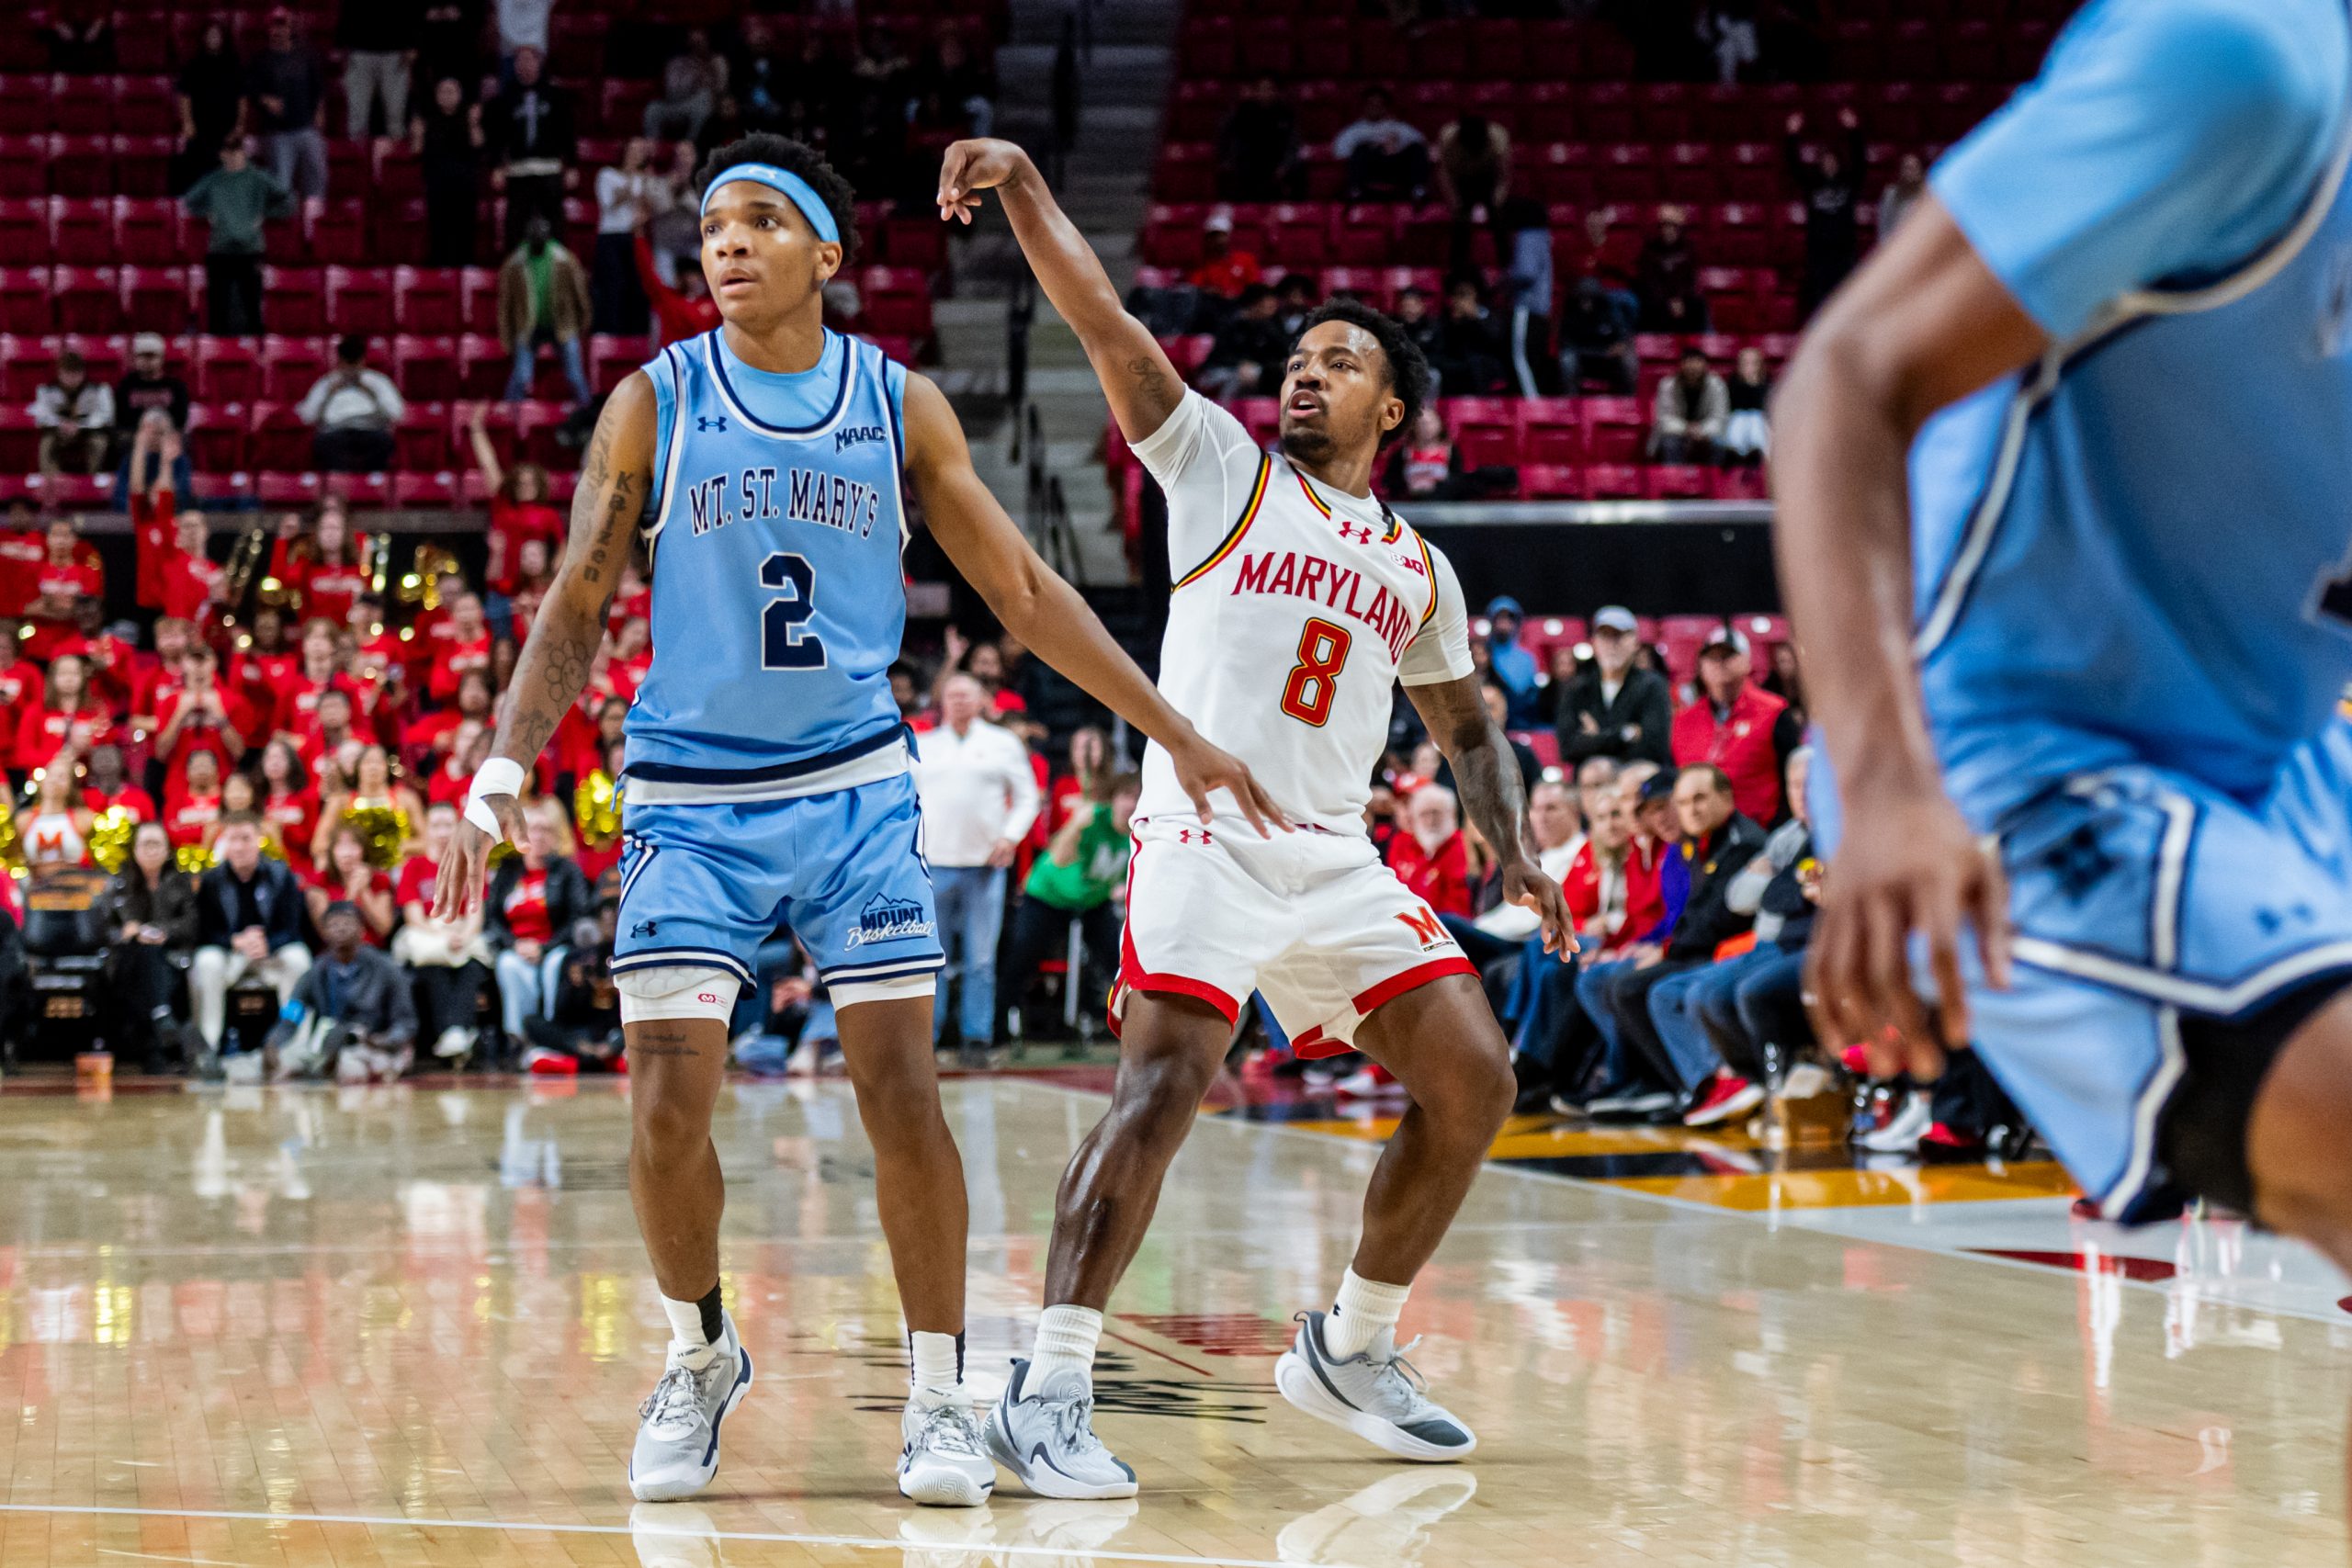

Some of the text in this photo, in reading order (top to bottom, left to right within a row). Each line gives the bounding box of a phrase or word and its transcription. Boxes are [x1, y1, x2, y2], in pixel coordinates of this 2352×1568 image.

[835, 426, 887, 455] MAAC
[690, 468, 879, 539] MT. ST. MARY'S
[758, 551, 828, 671] 2
[1230, 551, 1411, 666] MARYLAND
[1281, 616, 1351, 728] 8
[844, 919, 935, 952] Basketball
[860, 905, 923, 931] MOUNT
[1393, 906, 1451, 946] M
